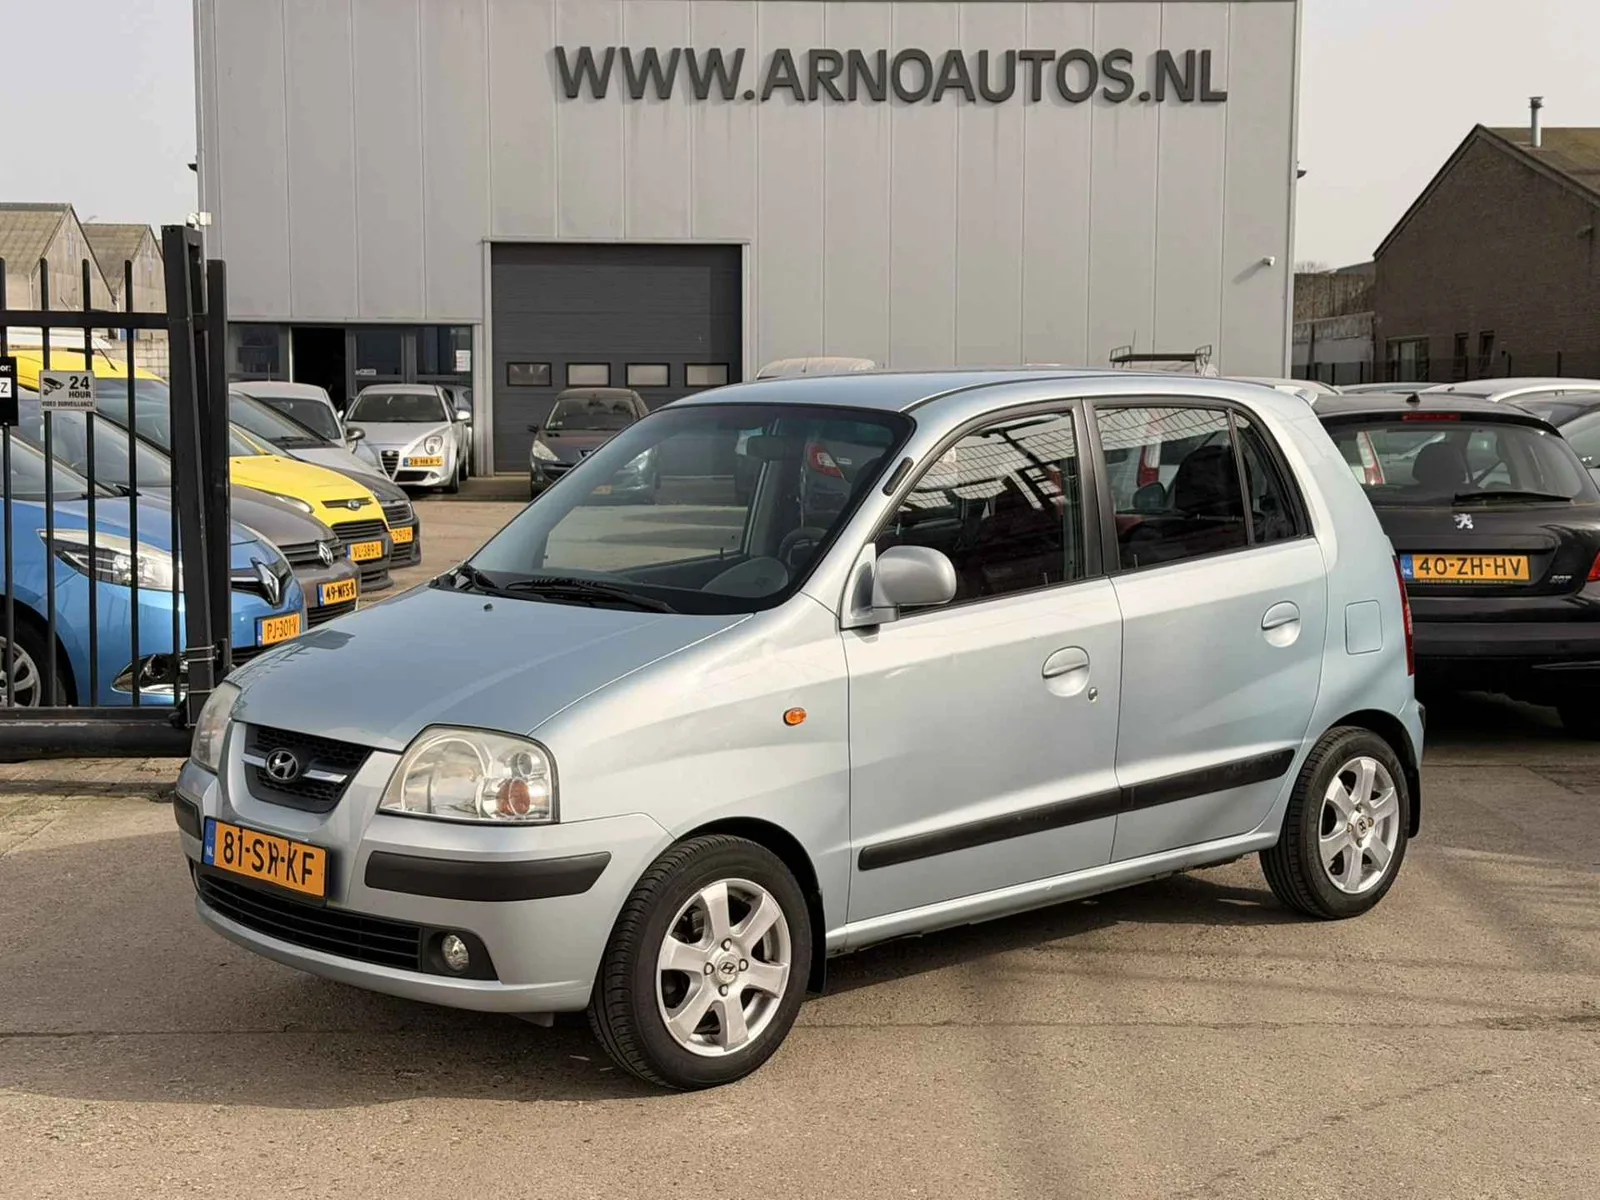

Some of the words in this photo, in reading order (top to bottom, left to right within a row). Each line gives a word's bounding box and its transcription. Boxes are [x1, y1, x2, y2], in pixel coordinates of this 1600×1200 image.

[554, 46, 1228, 103] WWW.ARNOAUTOS.NL
[69, 376, 90, 390] 24
[69, 391, 92, 399] HOUR
[1419, 557, 1522, 577] 40-ZH-HV
